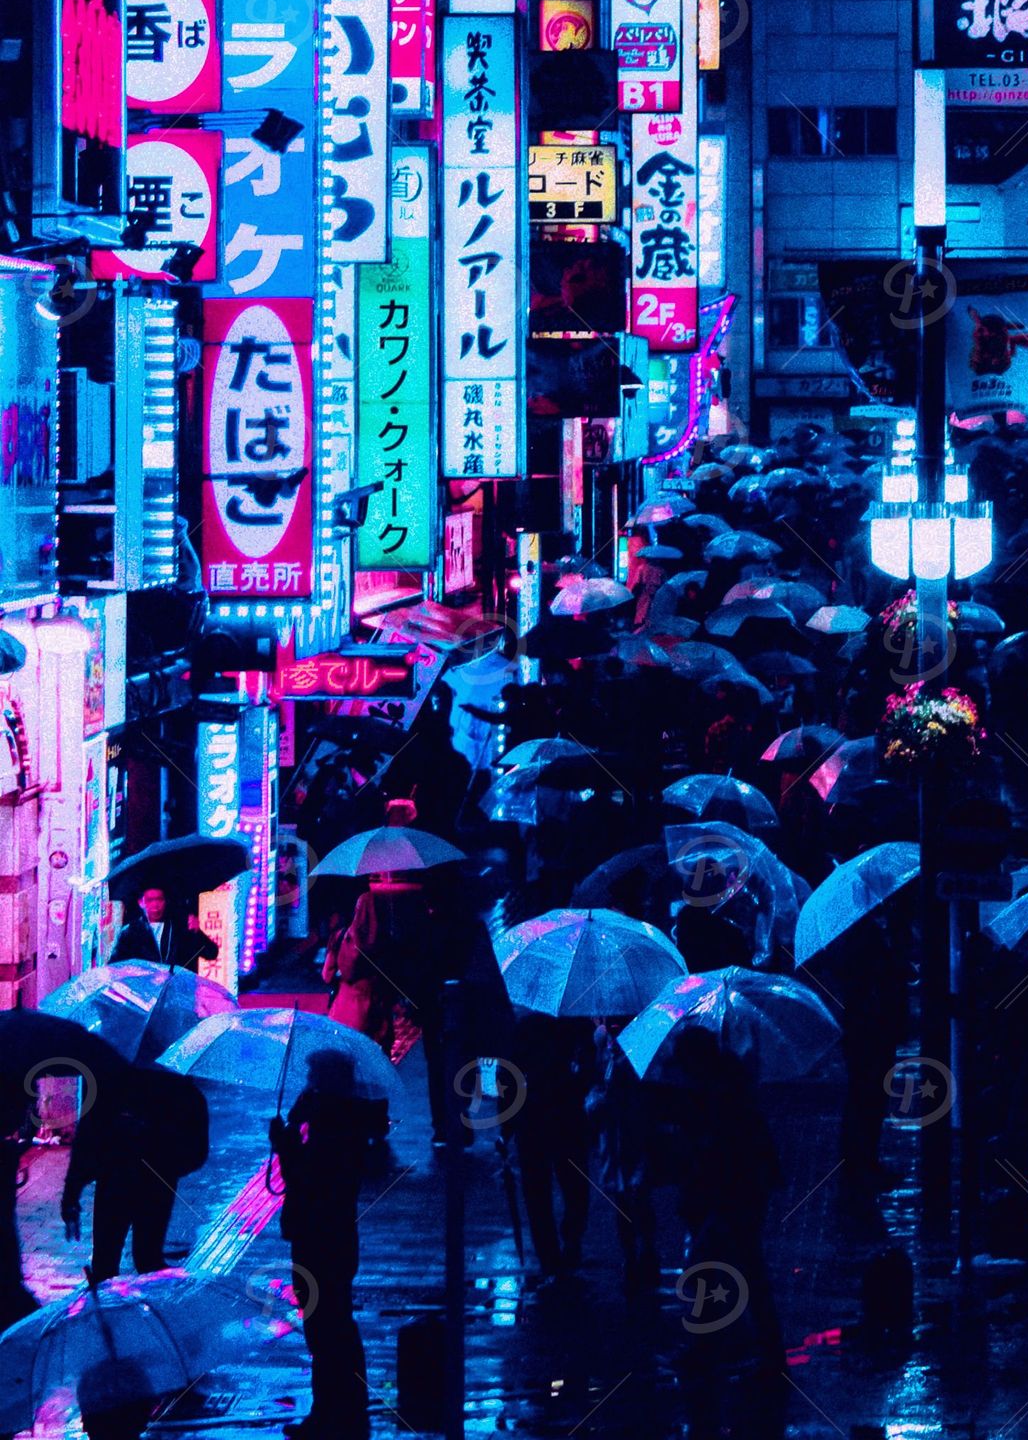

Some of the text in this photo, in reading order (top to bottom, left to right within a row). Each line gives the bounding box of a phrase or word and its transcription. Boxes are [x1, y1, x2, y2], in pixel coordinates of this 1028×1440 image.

[623, 82, 664, 109] B1
[458, 31, 508, 360] 喫茶室 ルノアール
[636, 151, 698, 281] 金の蔵
[637, 293, 676, 326] 2F
[225, 336, 293, 527] たばこ
[378, 299, 409, 555] カワノ・クォーク
[463, 384, 484, 474] 磯丸水産
[209, 562, 303, 592] 直売所
